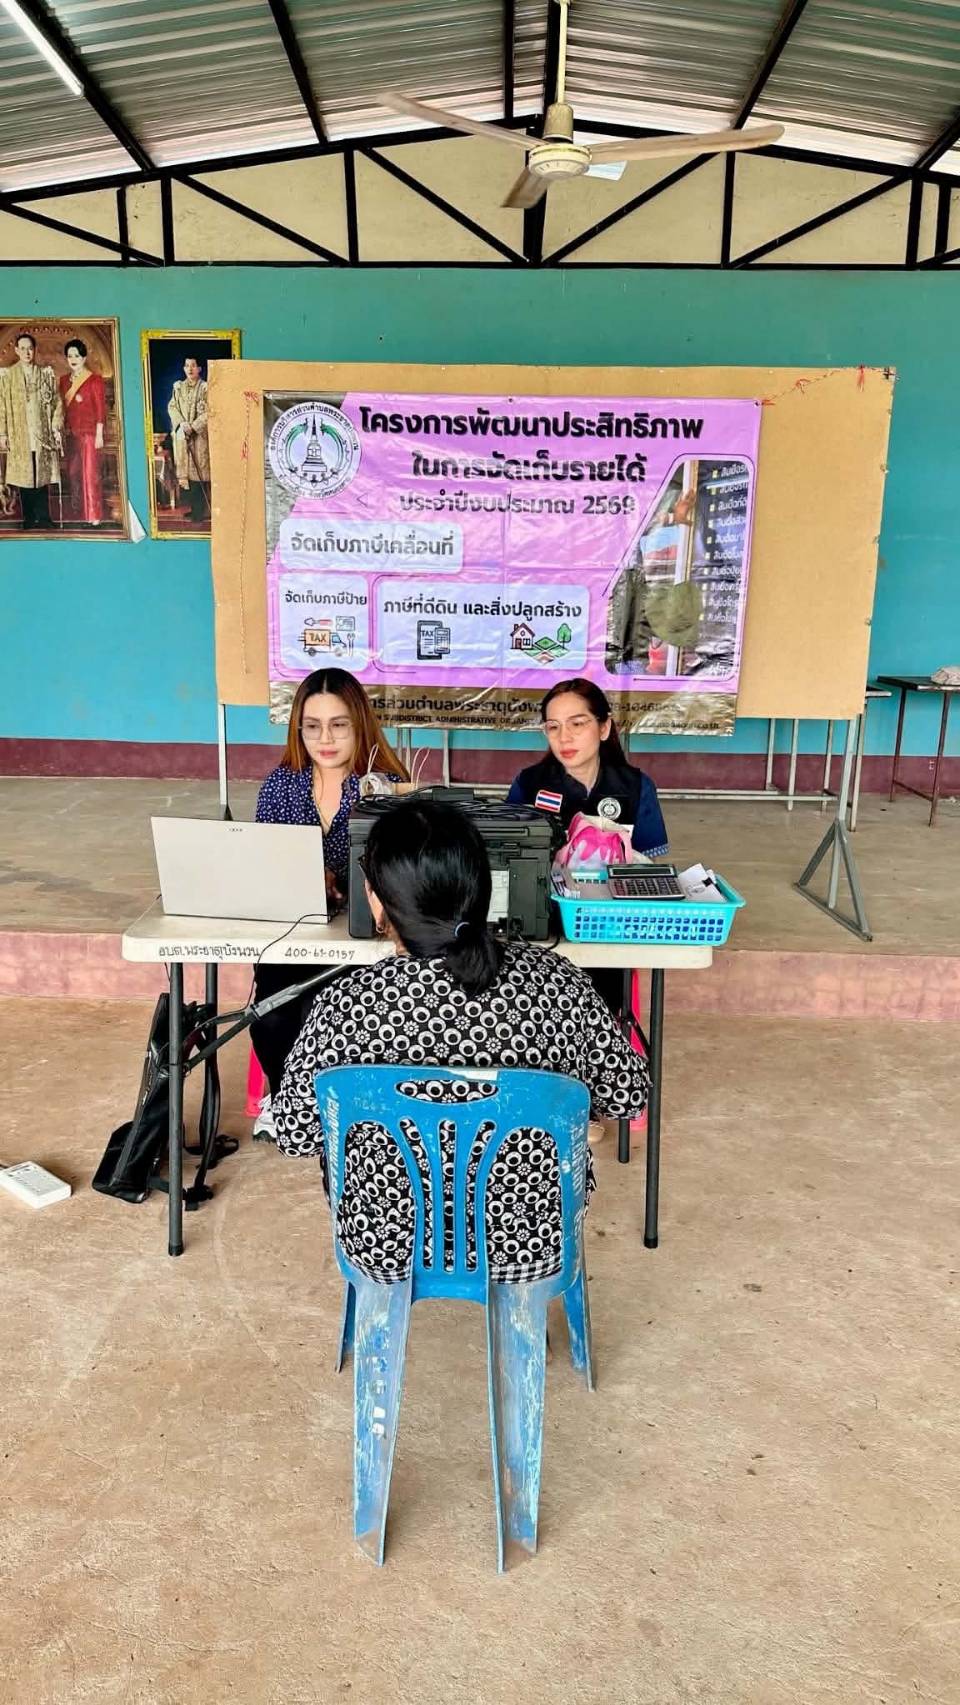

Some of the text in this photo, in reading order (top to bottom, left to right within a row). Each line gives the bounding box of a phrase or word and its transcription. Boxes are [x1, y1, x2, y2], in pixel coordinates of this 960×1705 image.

[359, 406, 704, 439] โครงการพัฒนาประสิทธิภาพ
[412, 449, 648, 482] ในการจัดเก็บรายได้
[400, 489, 575, 514] ประจำปีงบประมาณ
[290, 531, 454, 556] จัดเก็บภาษีเคลื่อนที่
[285, 590, 368, 606] จัดเก็บภาษีป้าย
[463, 596, 582, 622] และสิ่งปลูกสร้าง
[308, 632, 328, 643] TAX
